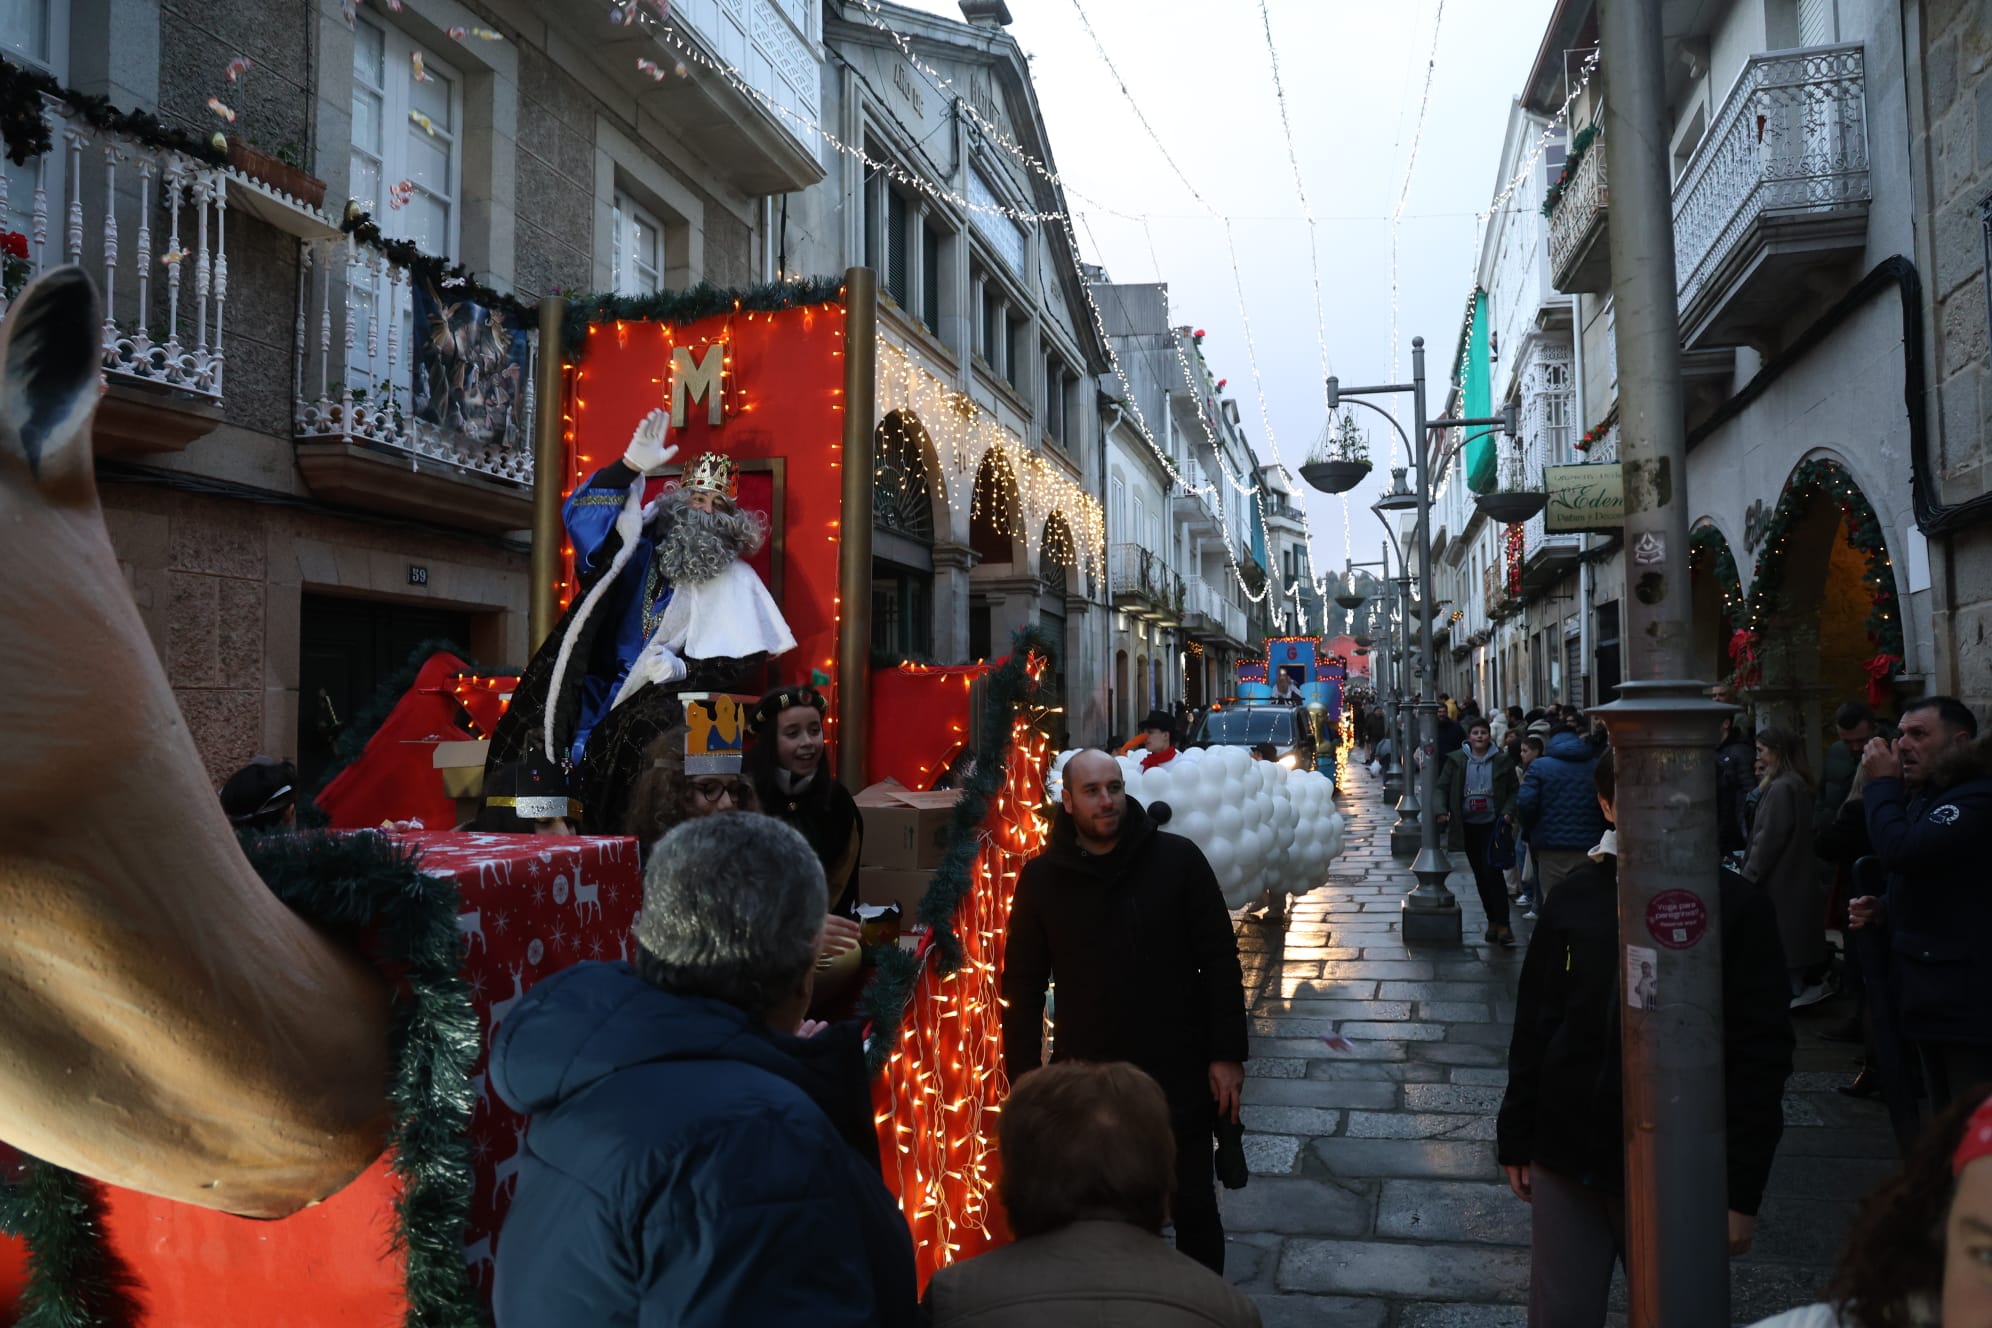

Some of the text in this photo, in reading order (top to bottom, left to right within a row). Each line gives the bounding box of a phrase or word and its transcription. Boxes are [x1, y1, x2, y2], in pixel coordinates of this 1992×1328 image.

[893, 63, 910, 102] AÑO
[671, 343, 725, 428] M
[411, 567, 427, 583] 59
[1287, 645, 1298, 660] G
